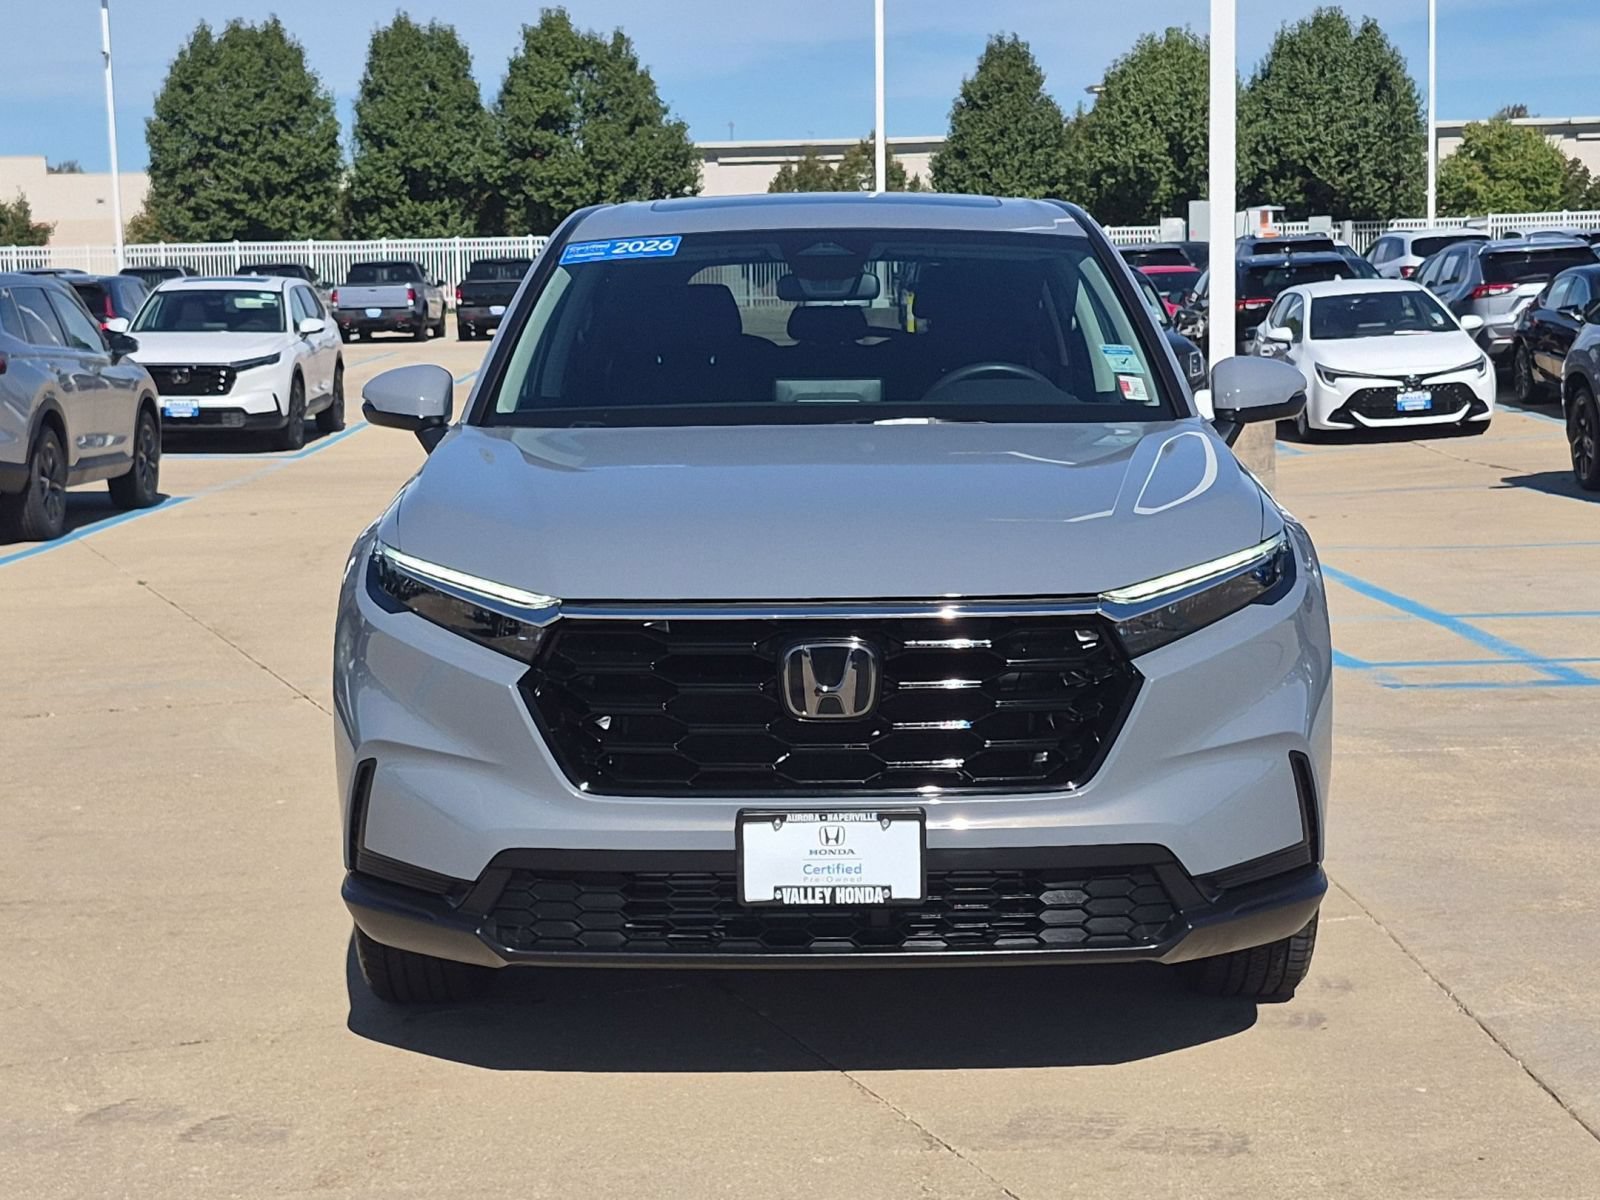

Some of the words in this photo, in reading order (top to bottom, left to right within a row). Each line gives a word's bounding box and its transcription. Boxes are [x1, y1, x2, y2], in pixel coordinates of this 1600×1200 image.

[612, 240, 674, 254] 2026
[786, 813, 820, 821] AURORA
[827, 812, 878, 821] NAPERVILLE
[803, 863, 862, 875] Certified
[782, 887, 832, 904] VALLEY
[836, 886, 884, 903] HONDA
